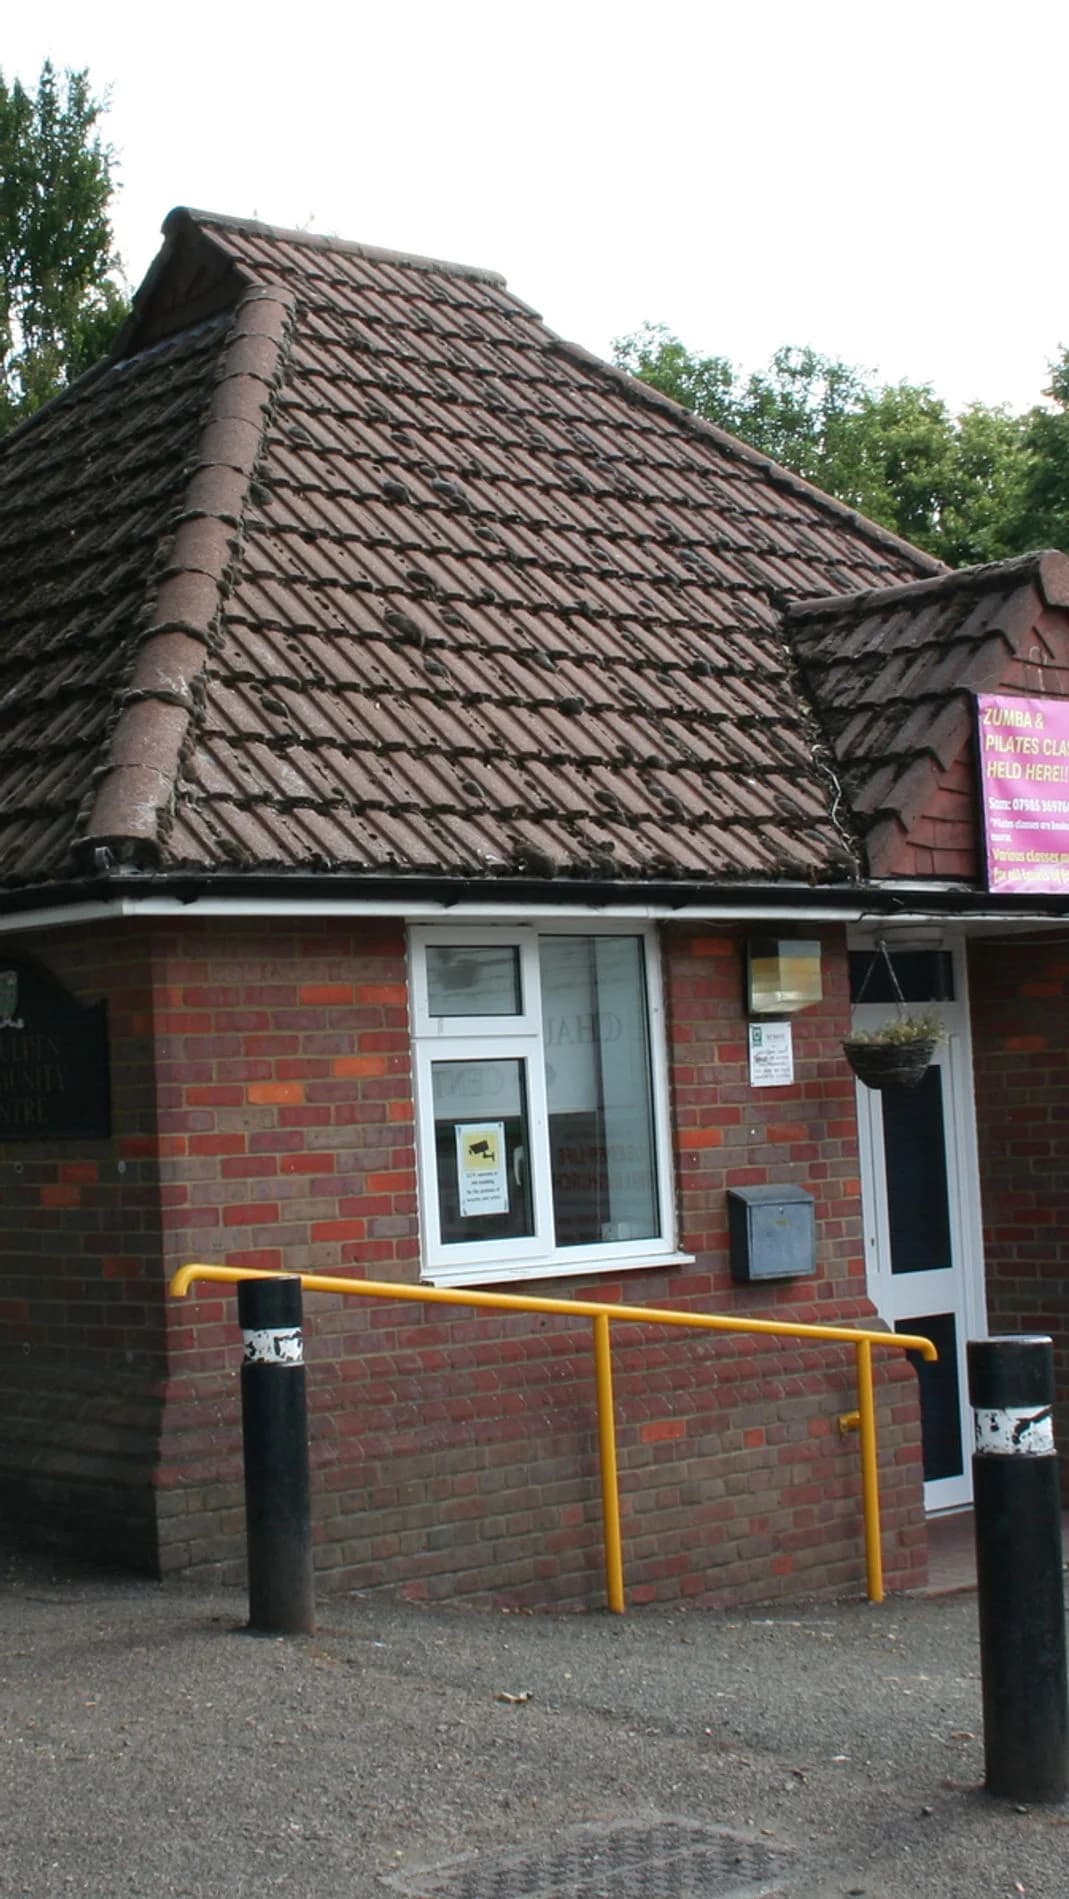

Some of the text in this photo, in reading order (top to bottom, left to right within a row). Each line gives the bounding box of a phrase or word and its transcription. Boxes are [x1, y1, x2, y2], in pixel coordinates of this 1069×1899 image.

[983, 707, 1044, 729] ZUMBA &
[985, 733, 1069, 757] PILATES CLA
[987, 761, 1022, 779] HELD
